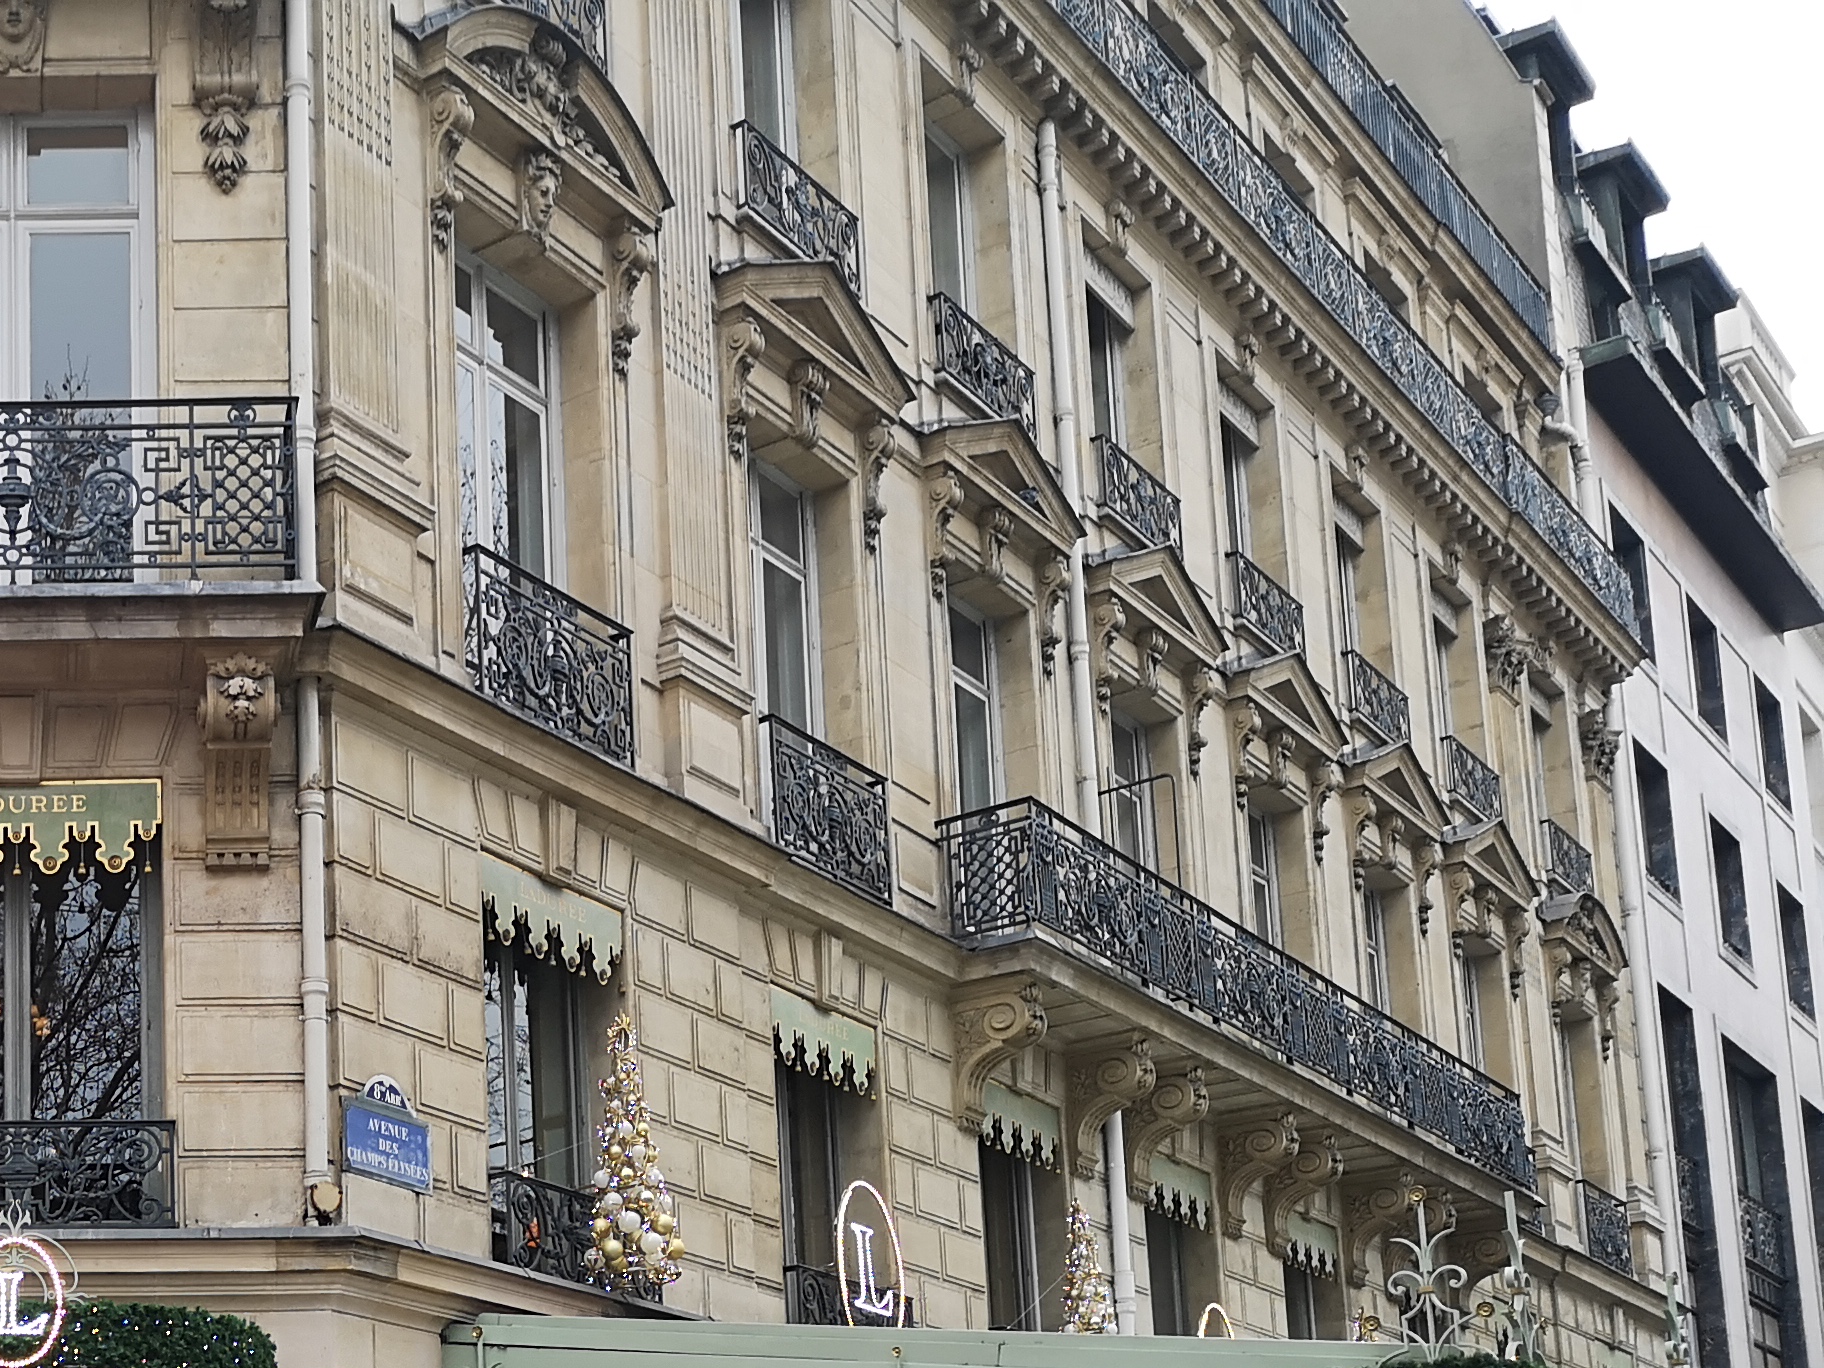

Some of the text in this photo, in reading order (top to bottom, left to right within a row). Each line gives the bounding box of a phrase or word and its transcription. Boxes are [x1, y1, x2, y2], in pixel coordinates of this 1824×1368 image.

[367, 1117, 409, 1142] AVENUE
[379, 1137, 399, 1155] DES
[347, 1146, 429, 1181] CHAMPS ÉLYSÉES
[850, 1222, 894, 1318] L
